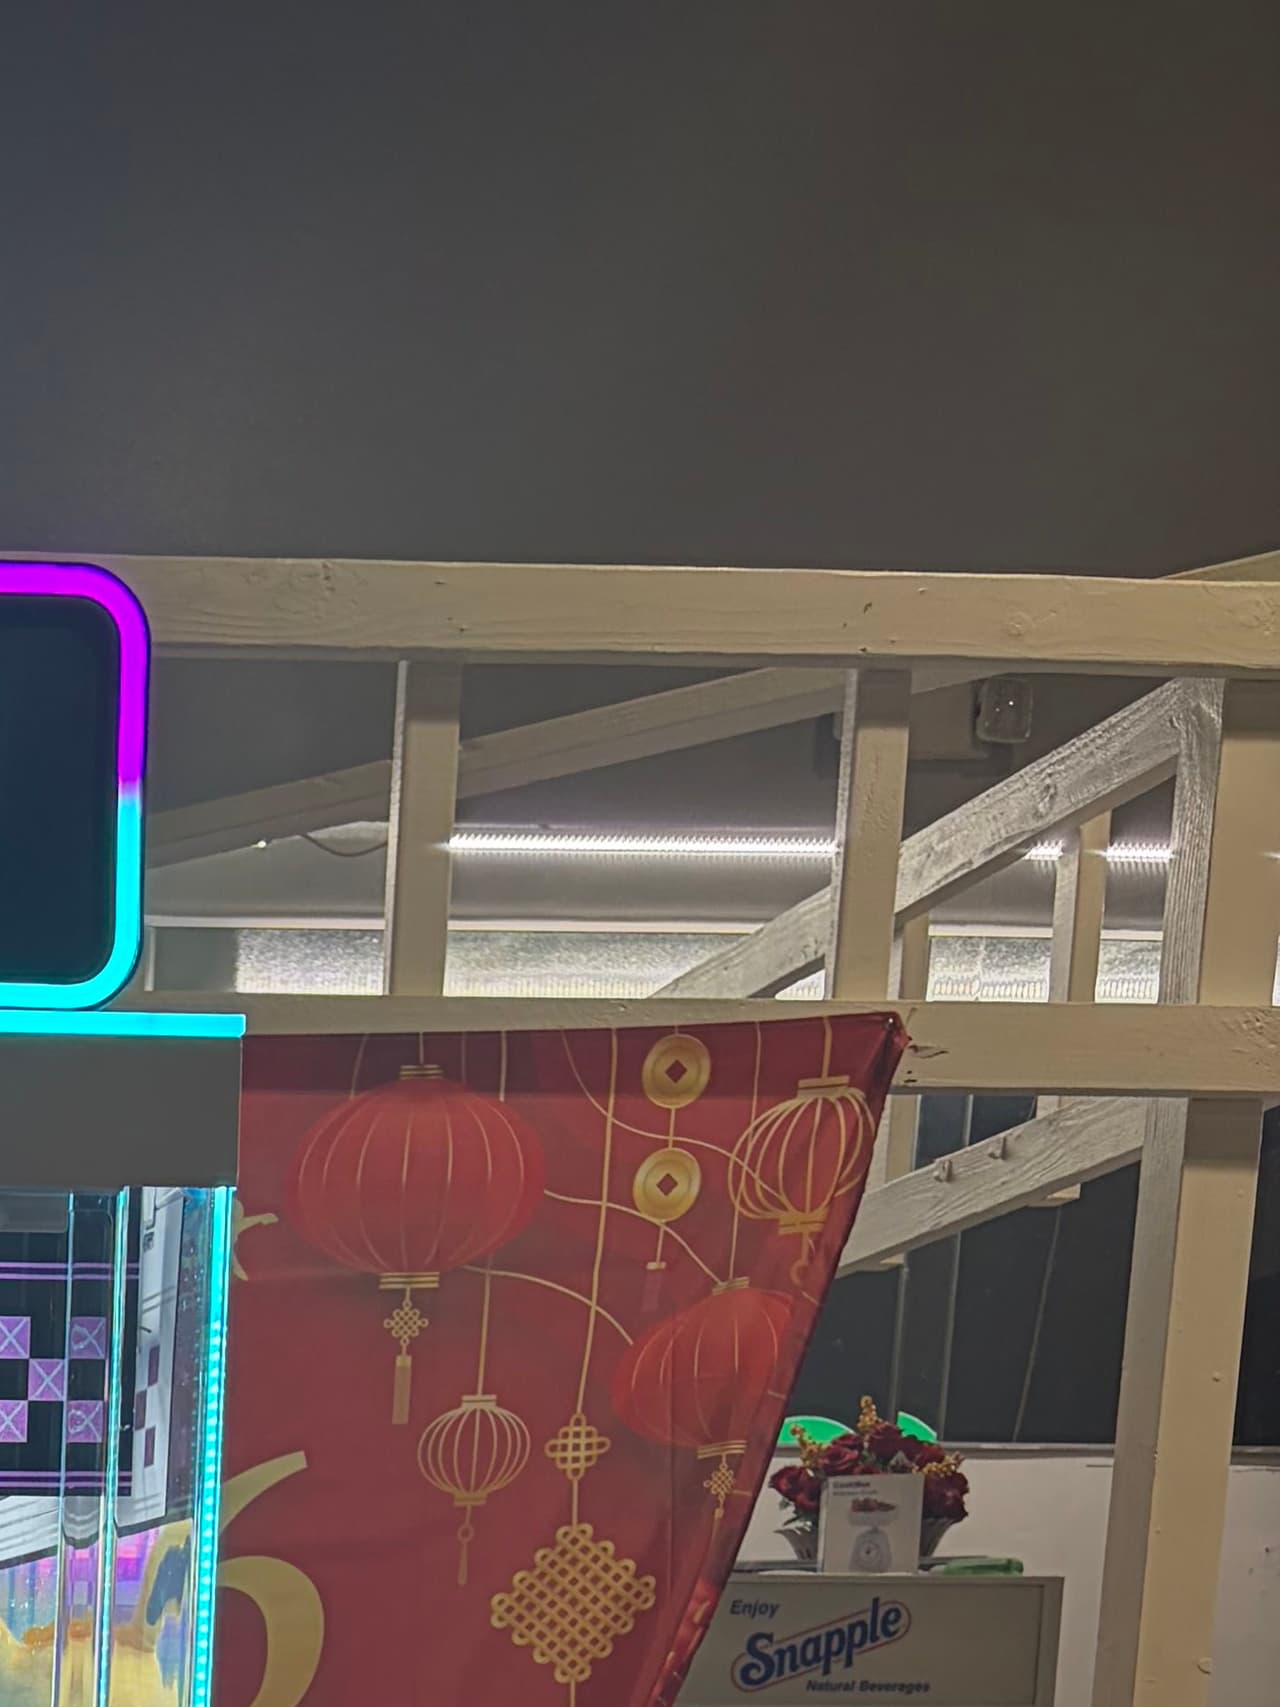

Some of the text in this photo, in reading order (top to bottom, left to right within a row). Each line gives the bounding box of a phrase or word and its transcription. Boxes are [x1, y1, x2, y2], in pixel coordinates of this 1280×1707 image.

[729, 1599, 779, 1619] Enjoy
[739, 1596, 903, 1686] Snapple
[806, 1680, 931, 1696] Natural Beverages
